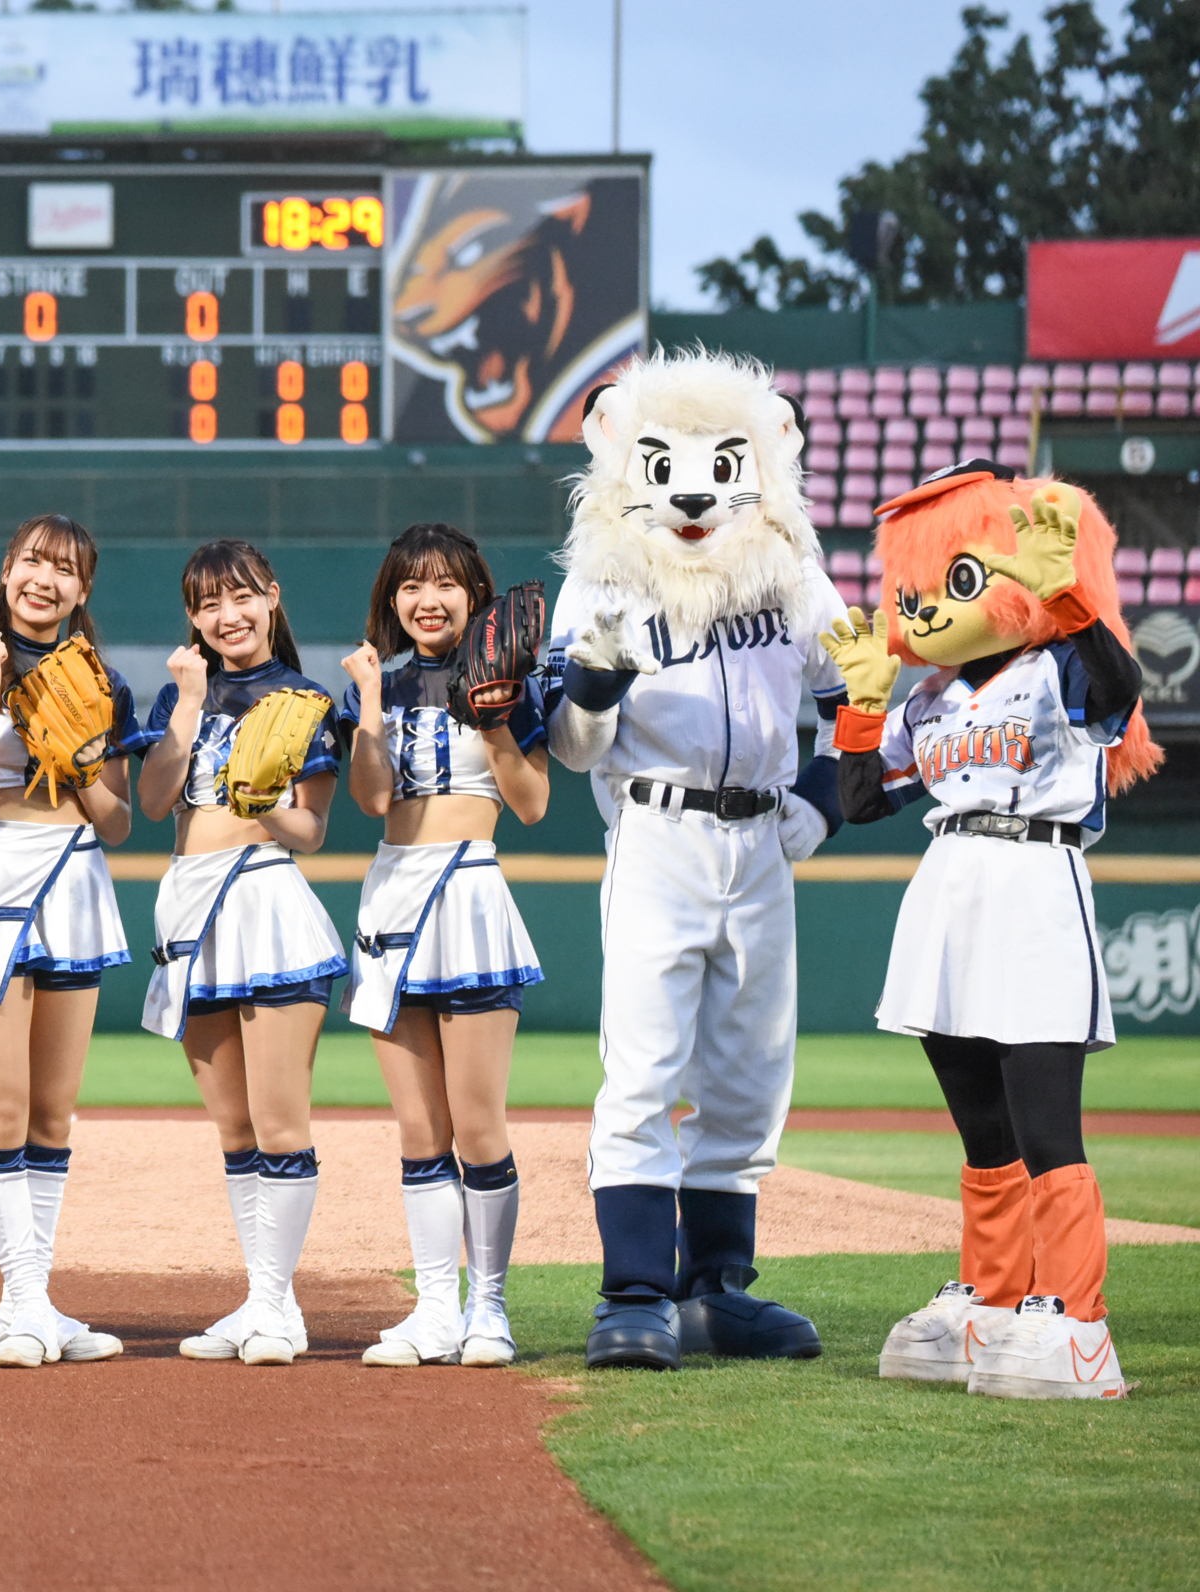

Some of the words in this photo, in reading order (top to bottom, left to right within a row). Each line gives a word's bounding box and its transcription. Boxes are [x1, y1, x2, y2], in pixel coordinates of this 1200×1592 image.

[134, 35, 430, 105] 瑞穗鮮乳
[263, 196, 384, 251] 18:29
[24, 291, 57, 342] 0
[186, 291, 218, 342] 0
